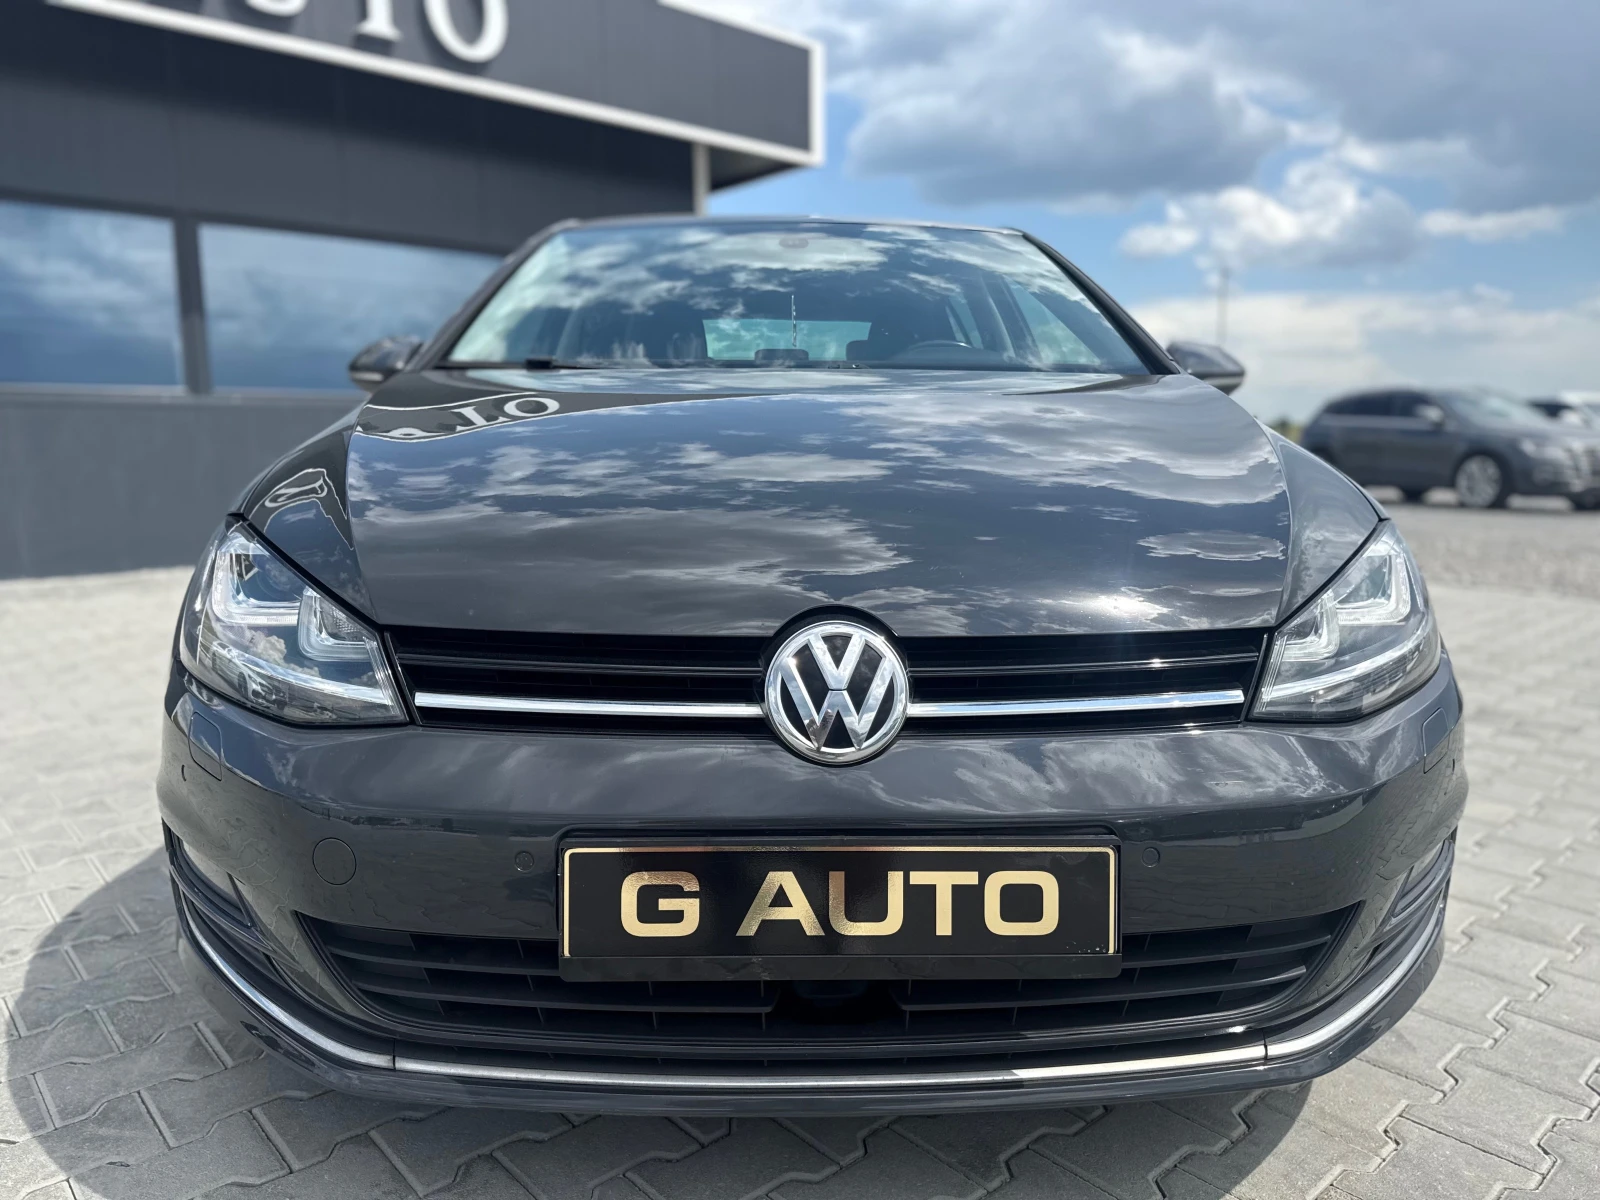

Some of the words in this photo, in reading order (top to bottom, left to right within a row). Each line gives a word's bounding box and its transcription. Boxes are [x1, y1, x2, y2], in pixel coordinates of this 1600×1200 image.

[770, 626, 904, 757] VW
[620, 870, 700, 938] G
[735, 870, 1060, 937] AUTO
